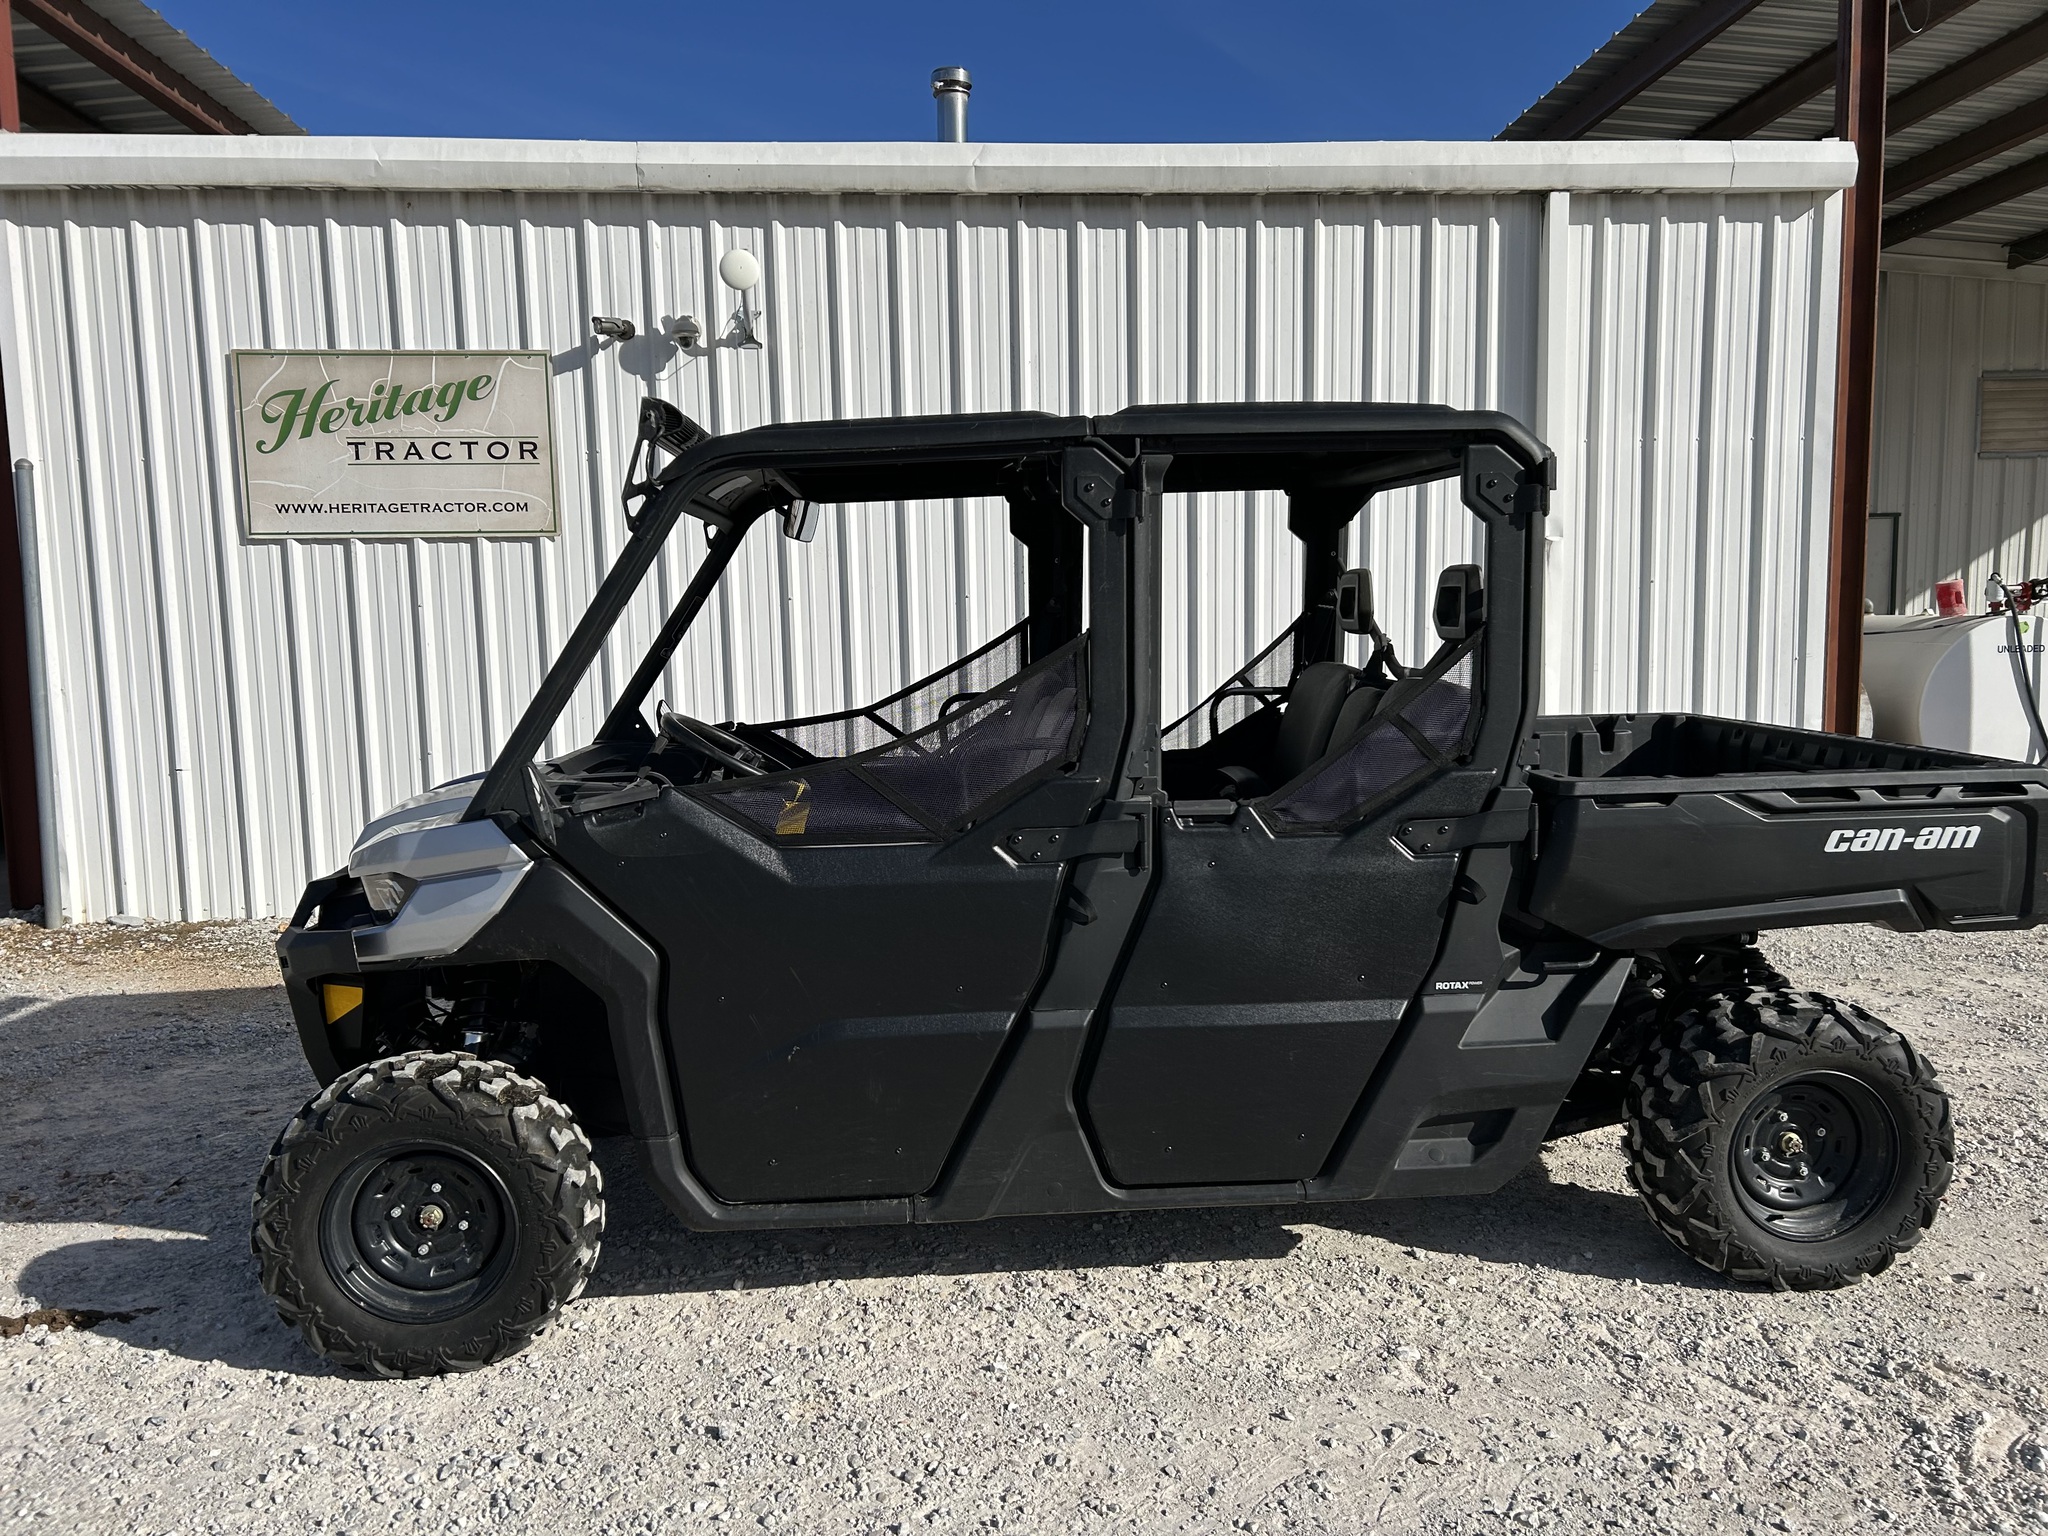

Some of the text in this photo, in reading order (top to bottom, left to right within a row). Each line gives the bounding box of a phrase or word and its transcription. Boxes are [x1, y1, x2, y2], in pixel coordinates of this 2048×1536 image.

[256, 374, 496, 454] Heritage
[347, 440, 539, 460] TRACTOR
[275, 501, 529, 514] WWW.HERITAGETRACTOR.COM
[1824, 825, 1981, 853] can-am
[1435, 981, 1469, 990] ROTAX
